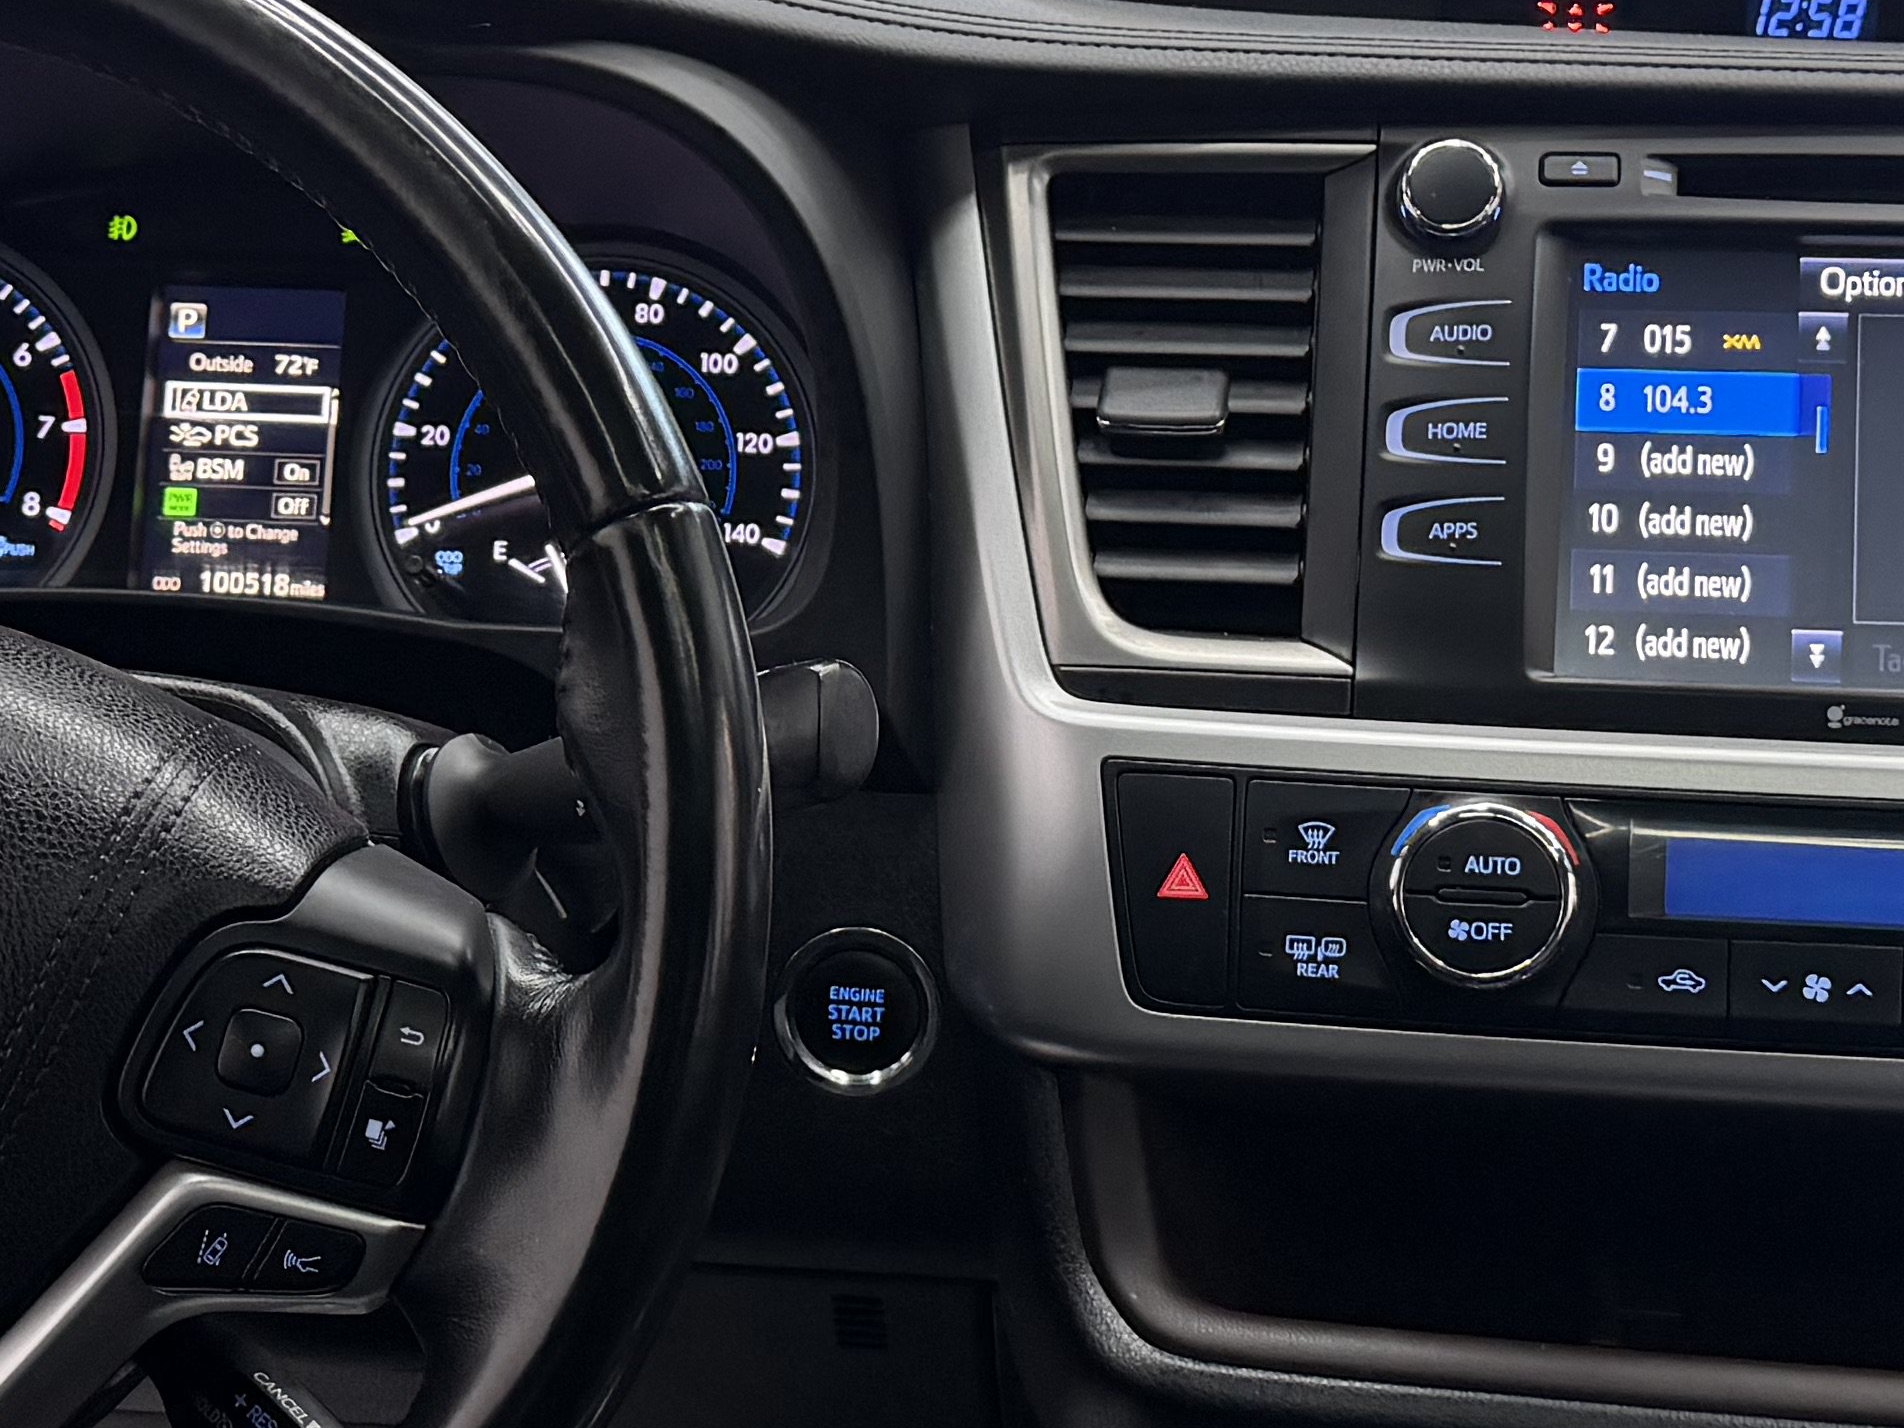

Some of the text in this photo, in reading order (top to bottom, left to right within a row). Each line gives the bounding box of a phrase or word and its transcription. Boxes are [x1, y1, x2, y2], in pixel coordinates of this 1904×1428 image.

[1582, 262, 1661, 295] Radio
[176, 309, 199, 334] P
[634, 303, 665, 325] 80
[1428, 323, 1494, 343] AUDIO
[1598, 322, 1619, 355] 7
[1643, 322, 1693, 355] 015
[13, 343, 34, 368] 6
[189, 352, 254, 374] Outside
[699, 352, 739, 374] 100
[202, 391, 249, 412] LDA
[1598, 383, 1714, 415] 8 104.3
[37, 414, 56, 440] 7
[213, 425, 259, 448] PCS
[419, 424, 451, 447] 20
[1426, 421, 1488, 441] HOME
[736, 431, 774, 455] 120
[196, 458, 311, 482] BSM On
[1597, 440, 1756, 481] 9 (add new)
[20, 490, 42, 517] 8
[277, 497, 310, 516] Off
[173, 521, 299, 544] Push to Change
[1428, 521, 1479, 542] APPS
[1587, 500, 1754, 542] 10 (add new)
[724, 521, 761, 546] 140
[171, 537, 228, 557] Settings
[493, 539, 509, 562] E
[199, 570, 291, 596] 100518
[1589, 560, 1752, 603] 11 (add new)
[1584, 622, 1751, 665] 12 (add new)
[1288, 848, 1340, 866] FRONT
[1463, 855, 1522, 876] AUTO
[1471, 920, 1513, 942] OFF
[1296, 961, 1340, 979] REAR
[829, 985, 886, 1004] ENGINE
[828, 1004, 886, 1023] START
[831, 1023, 881, 1042] STOP
[252, 1371, 309, 1425] CANCEL
